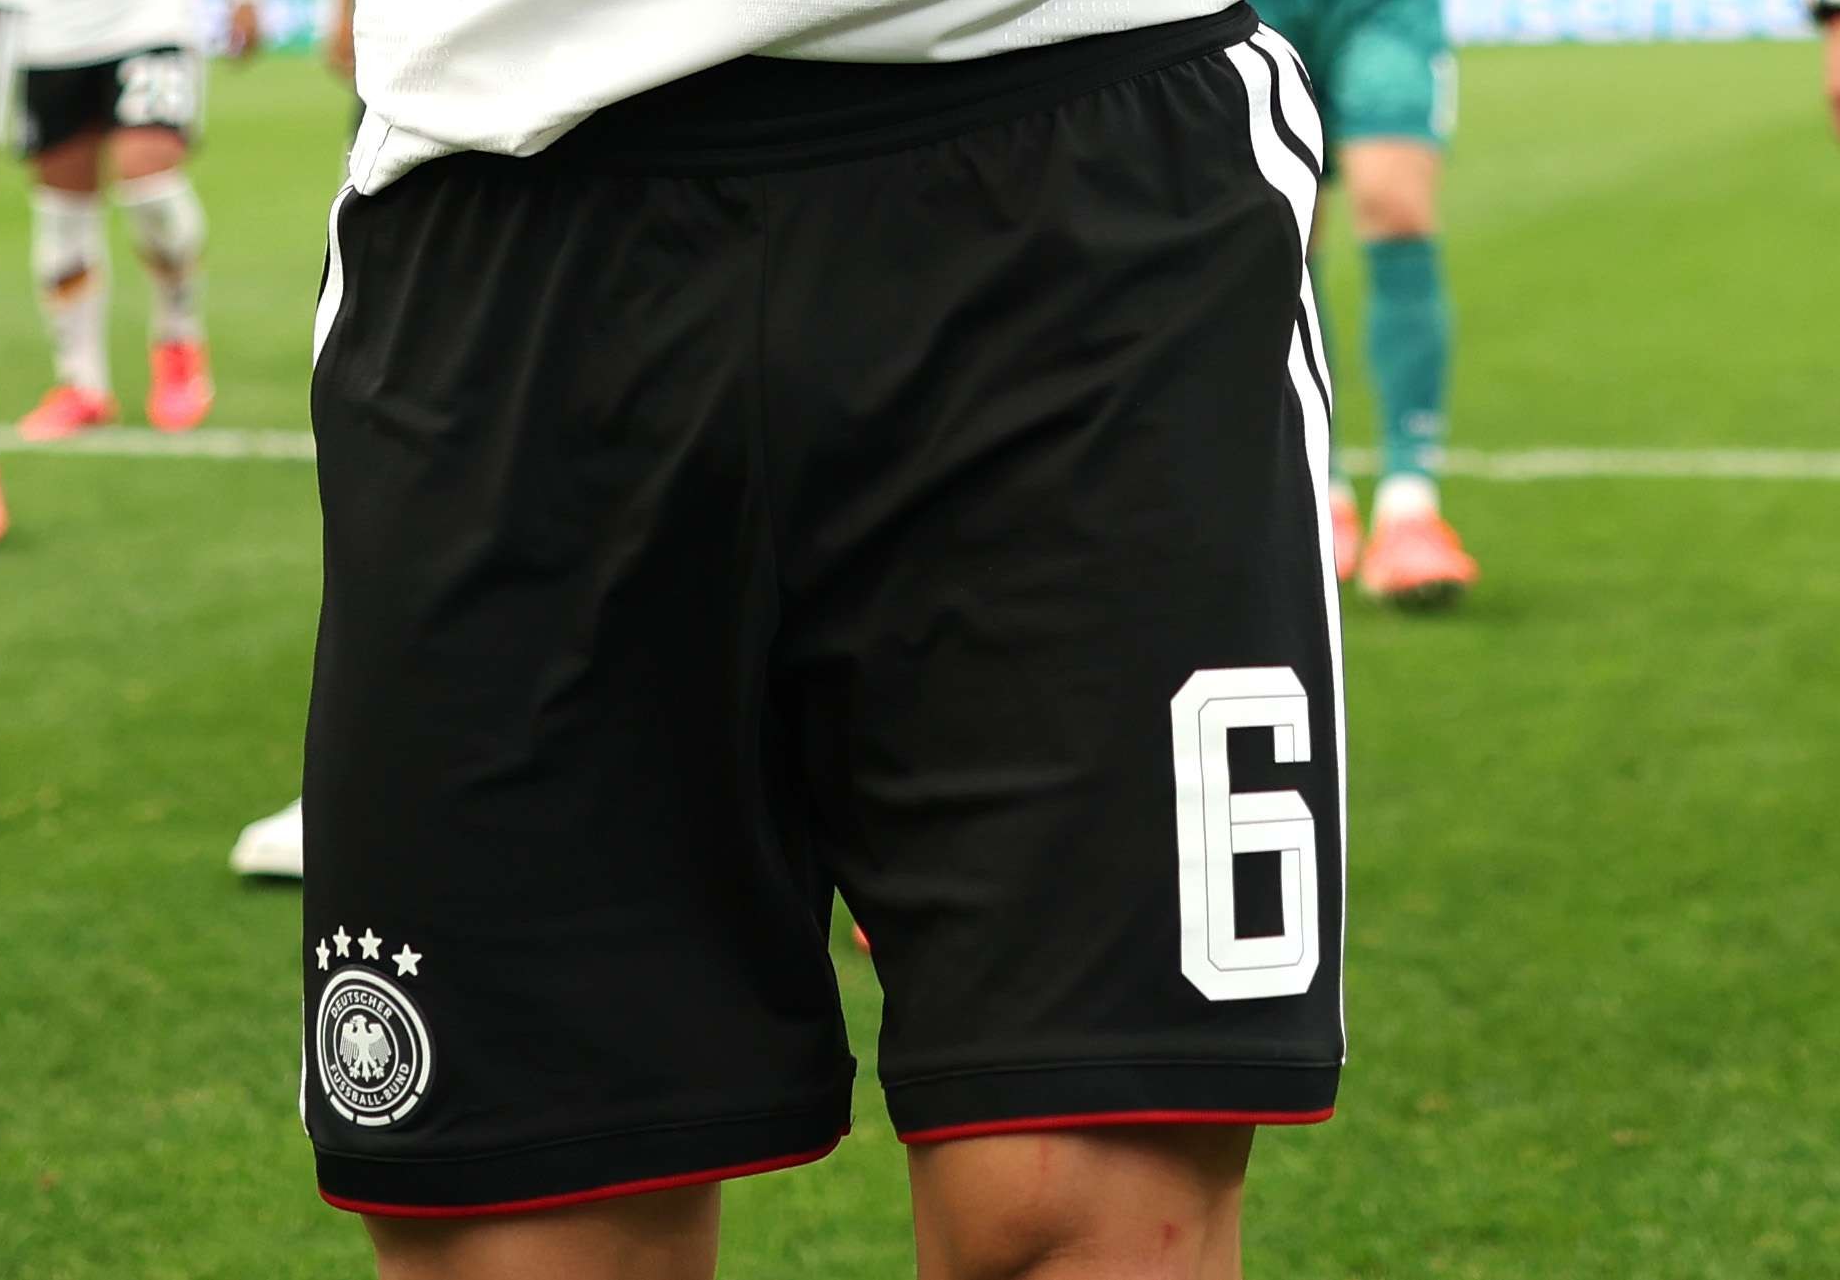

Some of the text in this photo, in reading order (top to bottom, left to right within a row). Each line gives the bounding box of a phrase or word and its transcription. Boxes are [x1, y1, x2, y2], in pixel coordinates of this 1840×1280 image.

[1171, 666, 1319, 1001] 6
[330, 990, 393, 1020] DEUTSCHER
[329, 1062, 410, 1105] FUSSBALL-BUND
